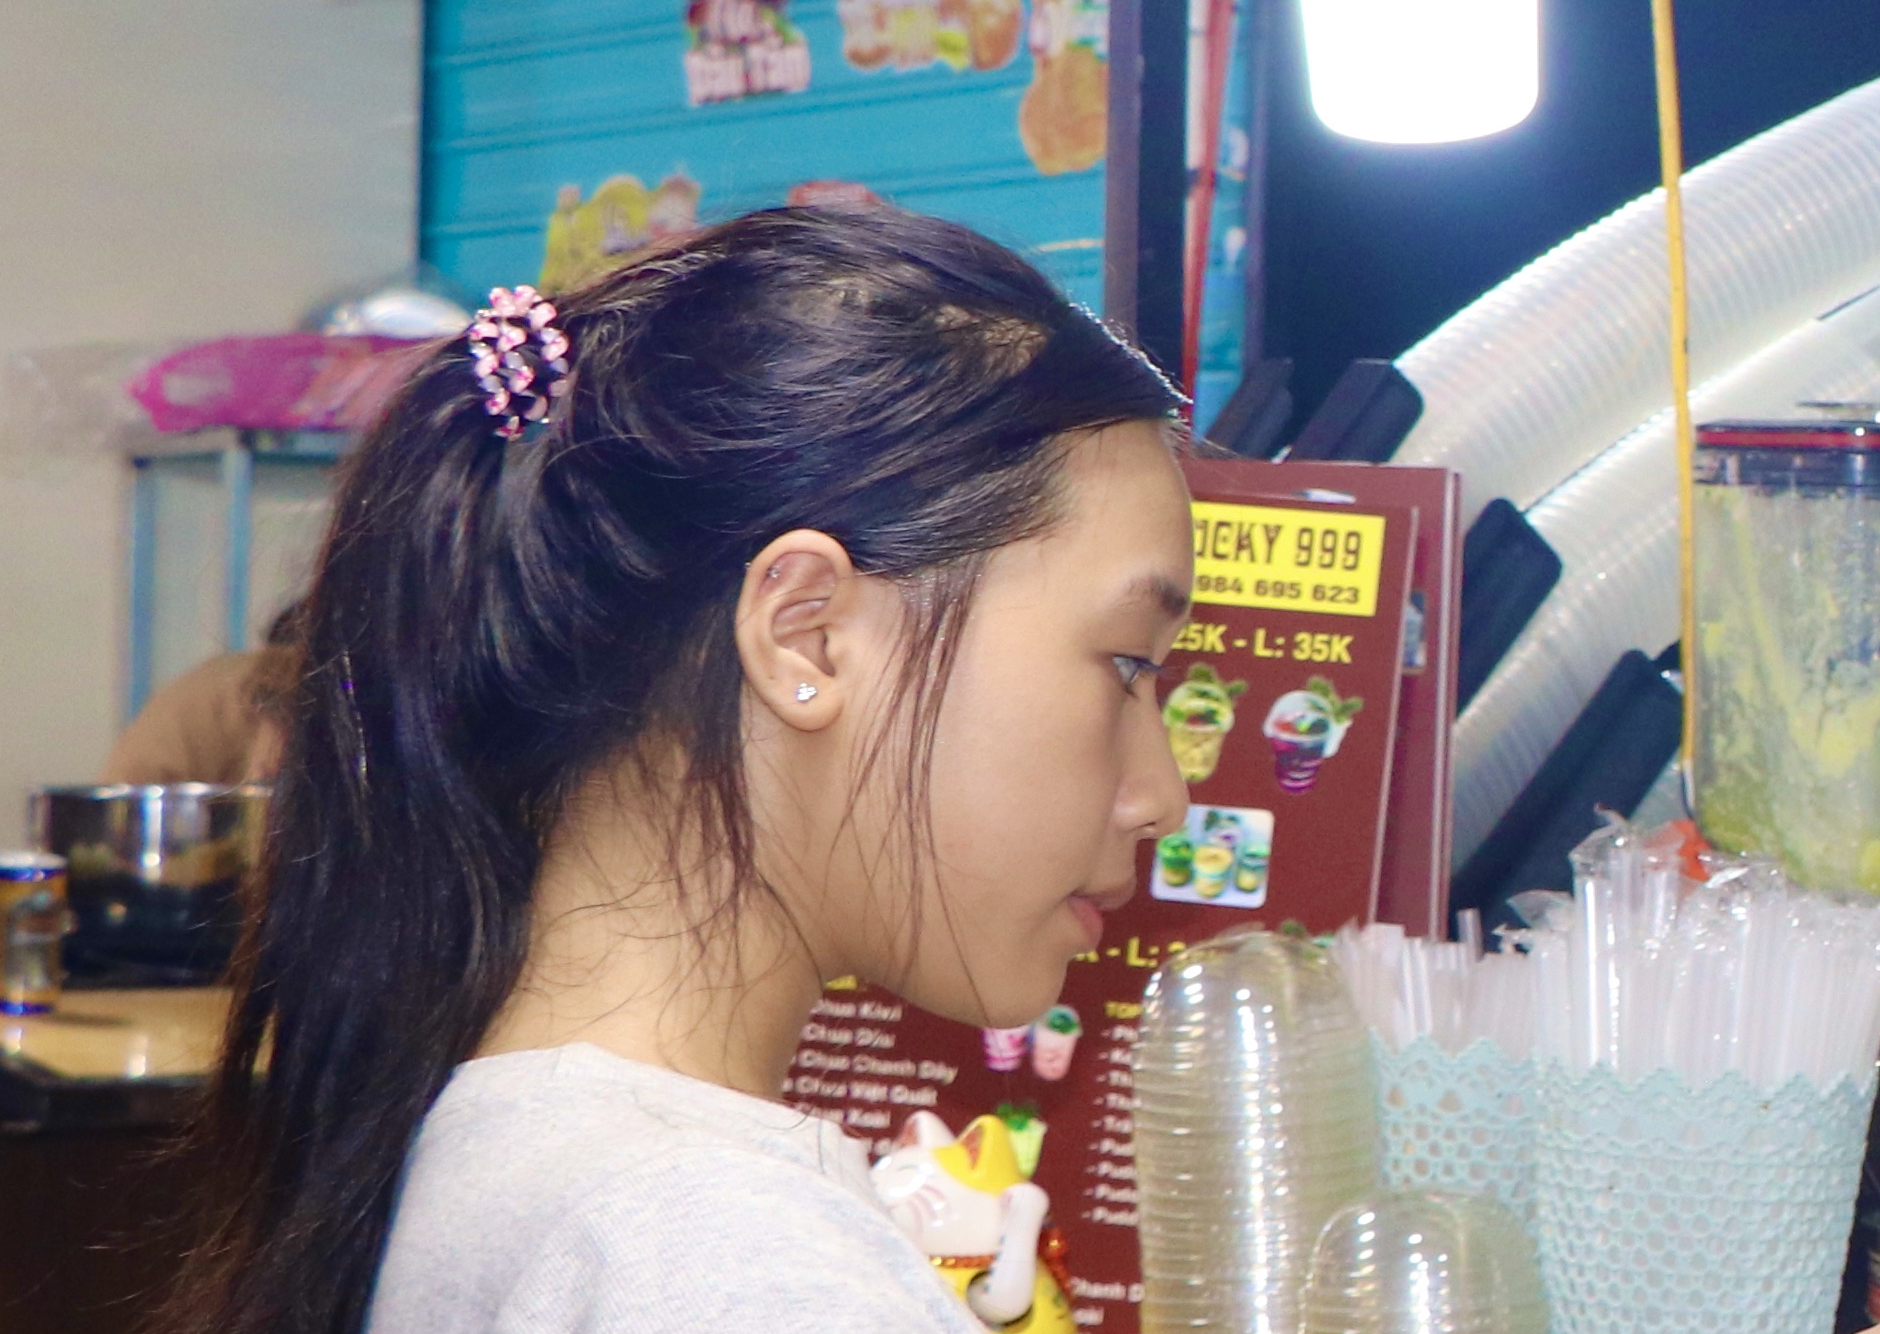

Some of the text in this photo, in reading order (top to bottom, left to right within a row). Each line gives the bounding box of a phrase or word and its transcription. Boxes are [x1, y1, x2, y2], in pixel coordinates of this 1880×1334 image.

[1295, 527, 1361, 571] 999
[1196, 574, 1359, 604] 984 695 623
[1254, 627, 1286, 659] L:
[1292, 631, 1354, 665] 35K
[858, 1001, 903, 1022] Kiwi
[851, 1053, 917, 1078] Chanh
